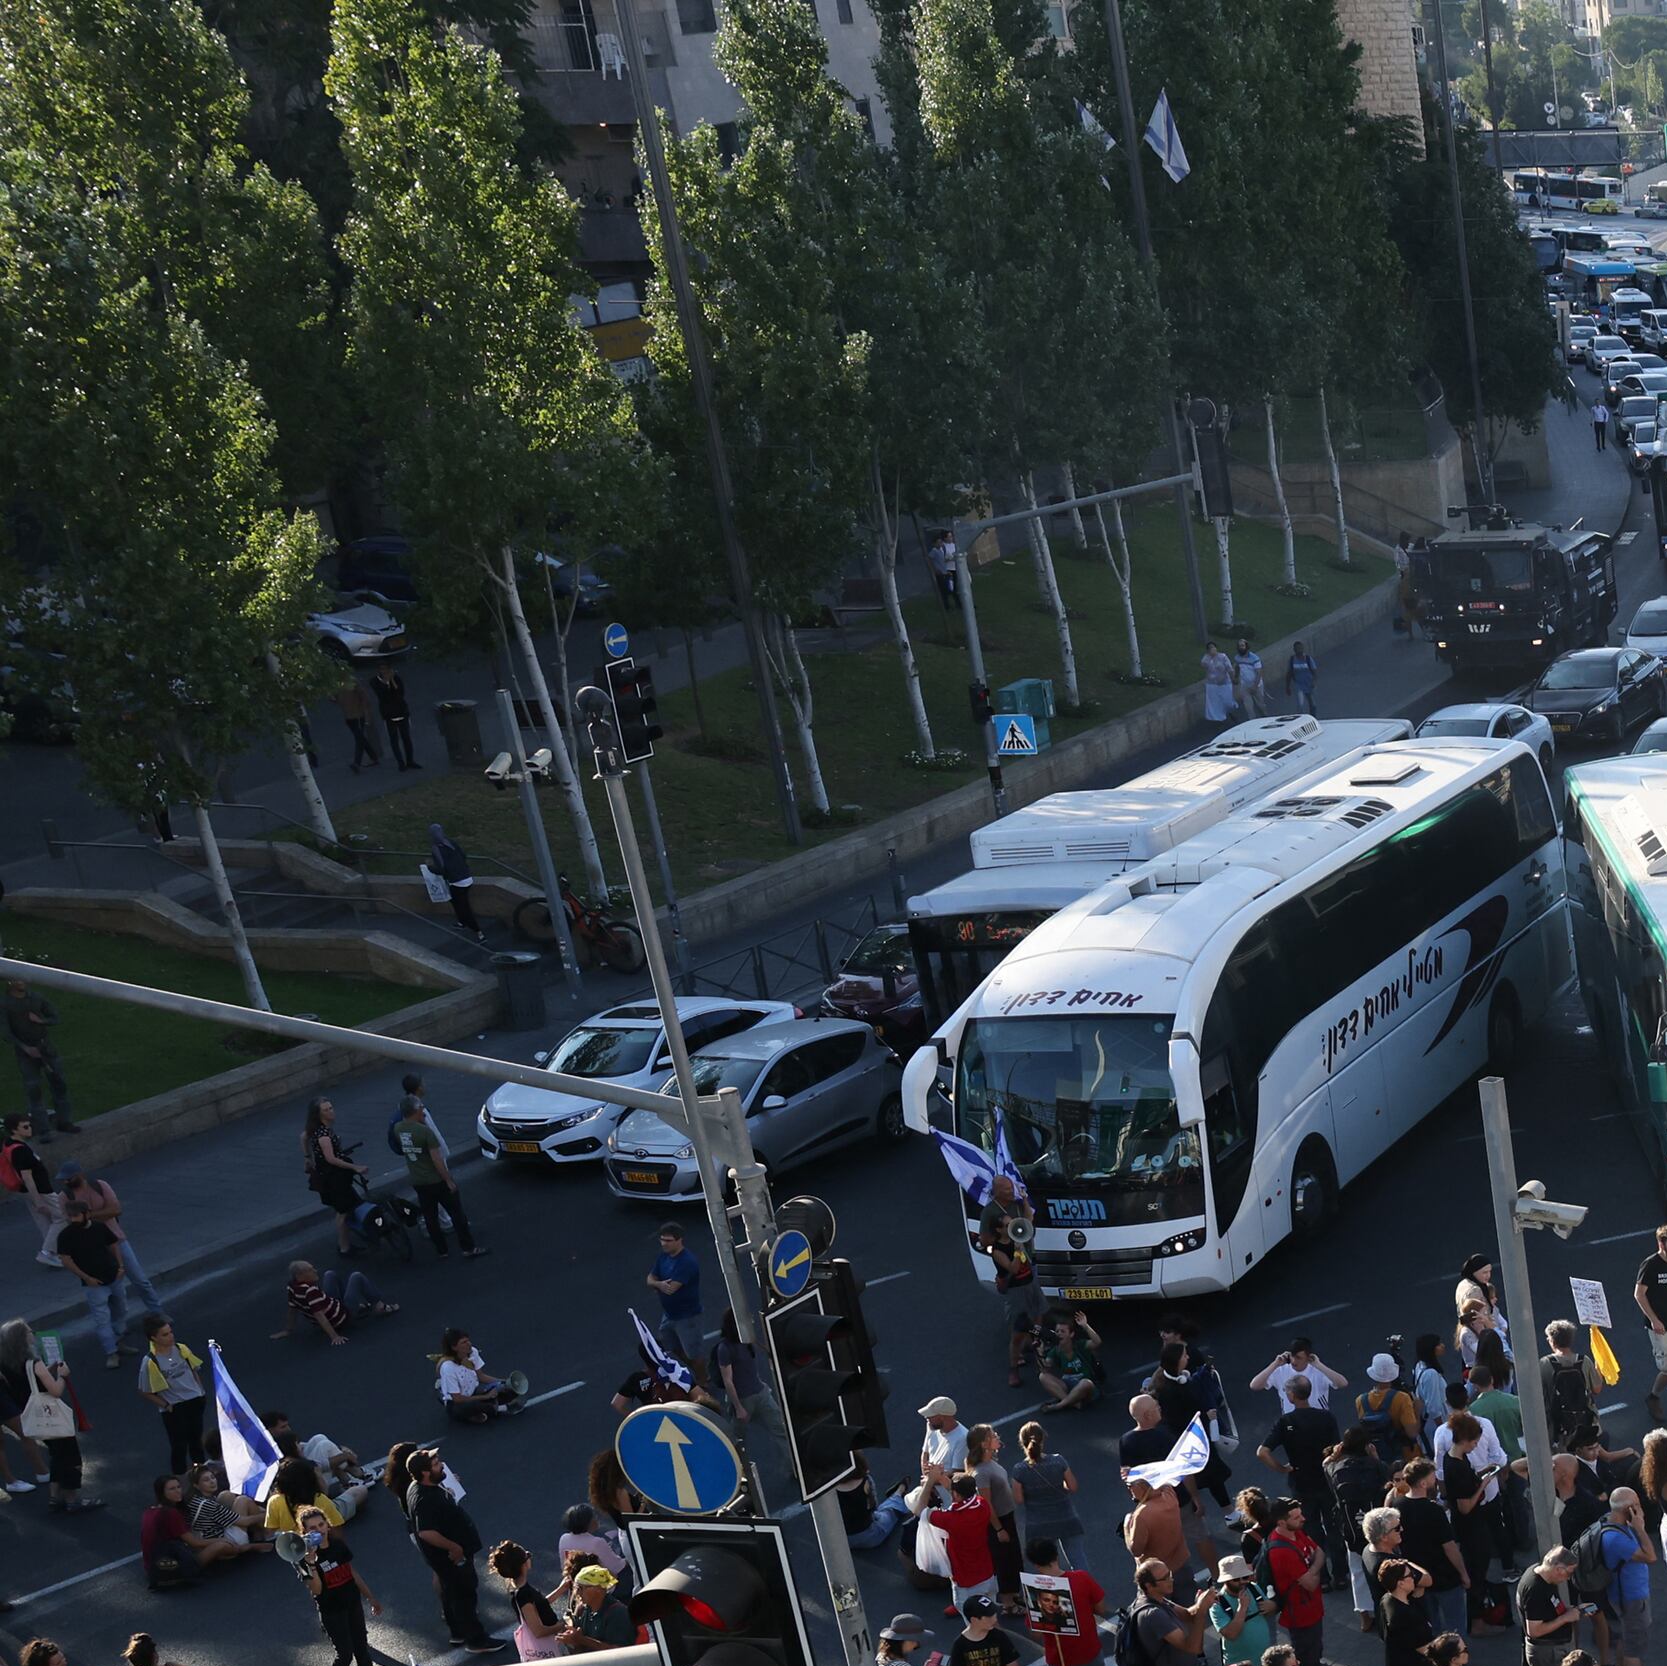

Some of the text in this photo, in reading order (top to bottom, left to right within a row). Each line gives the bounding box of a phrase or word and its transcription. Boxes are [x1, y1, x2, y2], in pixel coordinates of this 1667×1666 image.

[1003, 989, 1144, 1015] אחים דדון
[1362, 979, 1401, 1037] אחים
[1326, 1011, 1360, 1075] דדון
[1047, 1199, 1106, 1221] תנופה
